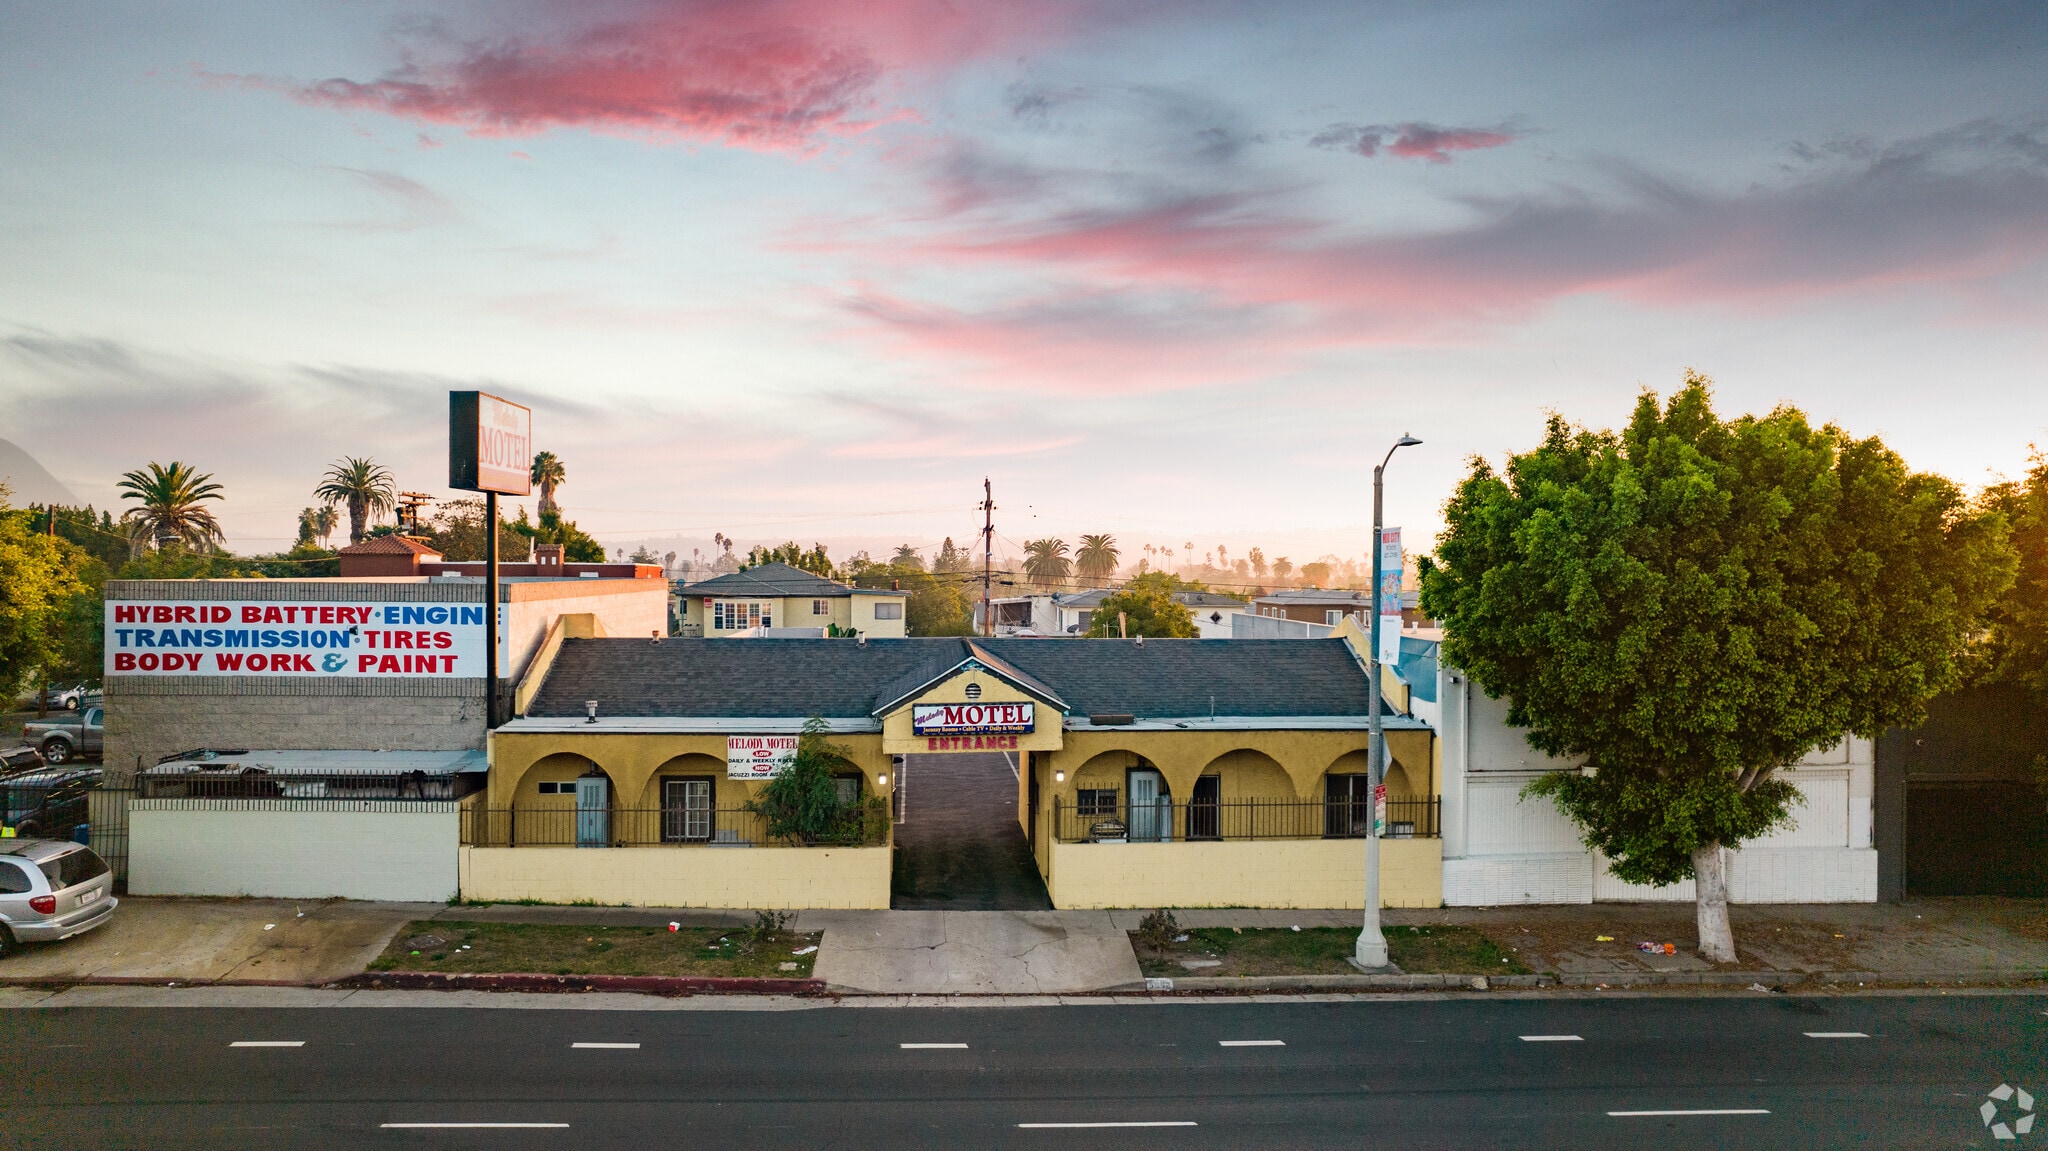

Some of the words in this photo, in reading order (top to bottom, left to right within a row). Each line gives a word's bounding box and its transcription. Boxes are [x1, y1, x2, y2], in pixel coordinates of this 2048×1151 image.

[480, 425, 529, 471] MOTEL
[115, 605, 232, 624] HYBRID
[241, 605, 372, 624] BATTERY
[384, 606, 501, 625] ENGIN
[115, 628, 350, 648] TRANSMISSION
[364, 630, 453, 649] TIRES
[115, 652, 203, 672] BODY
[216, 653, 317, 672] WORK
[321, 653, 349, 673] &
[357, 655, 459, 673] PAINT
[914, 709, 945, 725] Melody
[943, 704, 1031, 725] MOTEL
[728, 738, 764, 750] MELODY
[767, 738, 798, 750] MOTEL
[928, 736, 1018, 750] ENTRANCE
